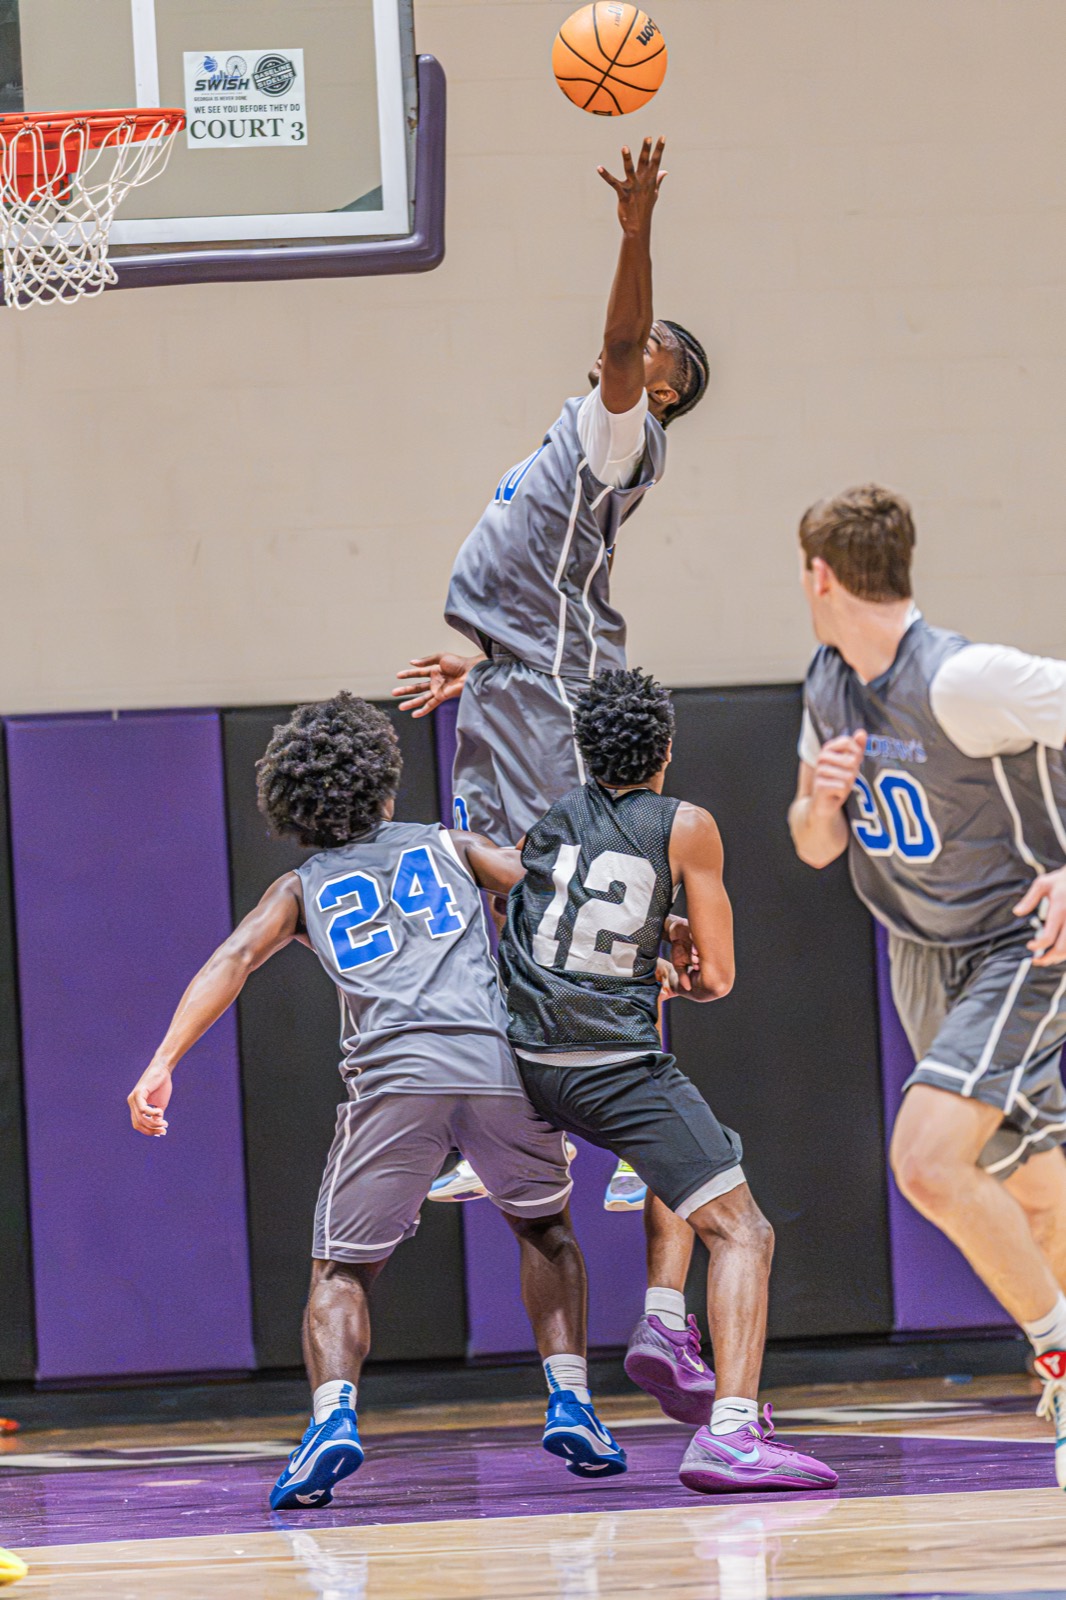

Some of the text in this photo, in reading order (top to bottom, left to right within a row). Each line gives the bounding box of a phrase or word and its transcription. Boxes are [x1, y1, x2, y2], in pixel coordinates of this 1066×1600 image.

[254, 63, 291, 80] BASELINE
[194, 78, 250, 91] SWISH
[194, 103, 300, 114] WE SEE YOU BEFORE THEY DO
[190, 118, 305, 141] COURT 3
[852, 768, 942, 864] 30
[316, 845, 467, 973] 24
[532, 843, 657, 977] 12
